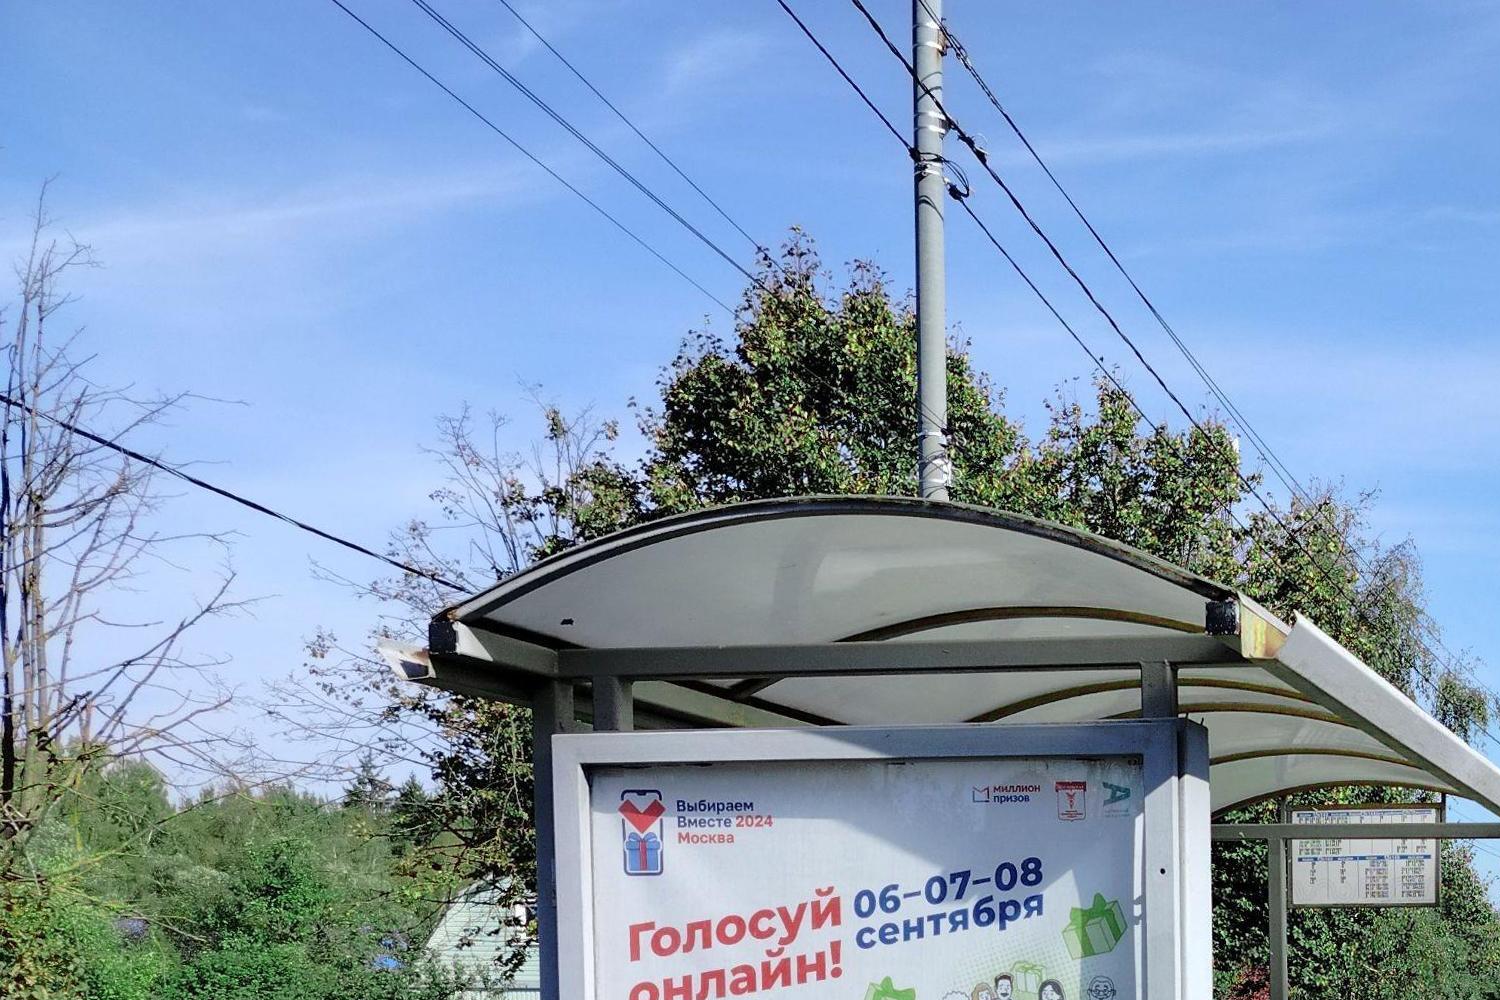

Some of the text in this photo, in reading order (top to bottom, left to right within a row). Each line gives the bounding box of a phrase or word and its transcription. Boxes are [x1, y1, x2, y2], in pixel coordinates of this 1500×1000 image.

[993, 785, 1040, 793] миллион
[994, 795, 1029, 804] призов
[677, 801, 754, 814] Выбираем
[678, 816, 772, 828] Вместе 2024
[678, 832, 734, 844] Москва
[629, 886, 841, 962] Голосуй
[855, 893, 1044, 950] сентября
